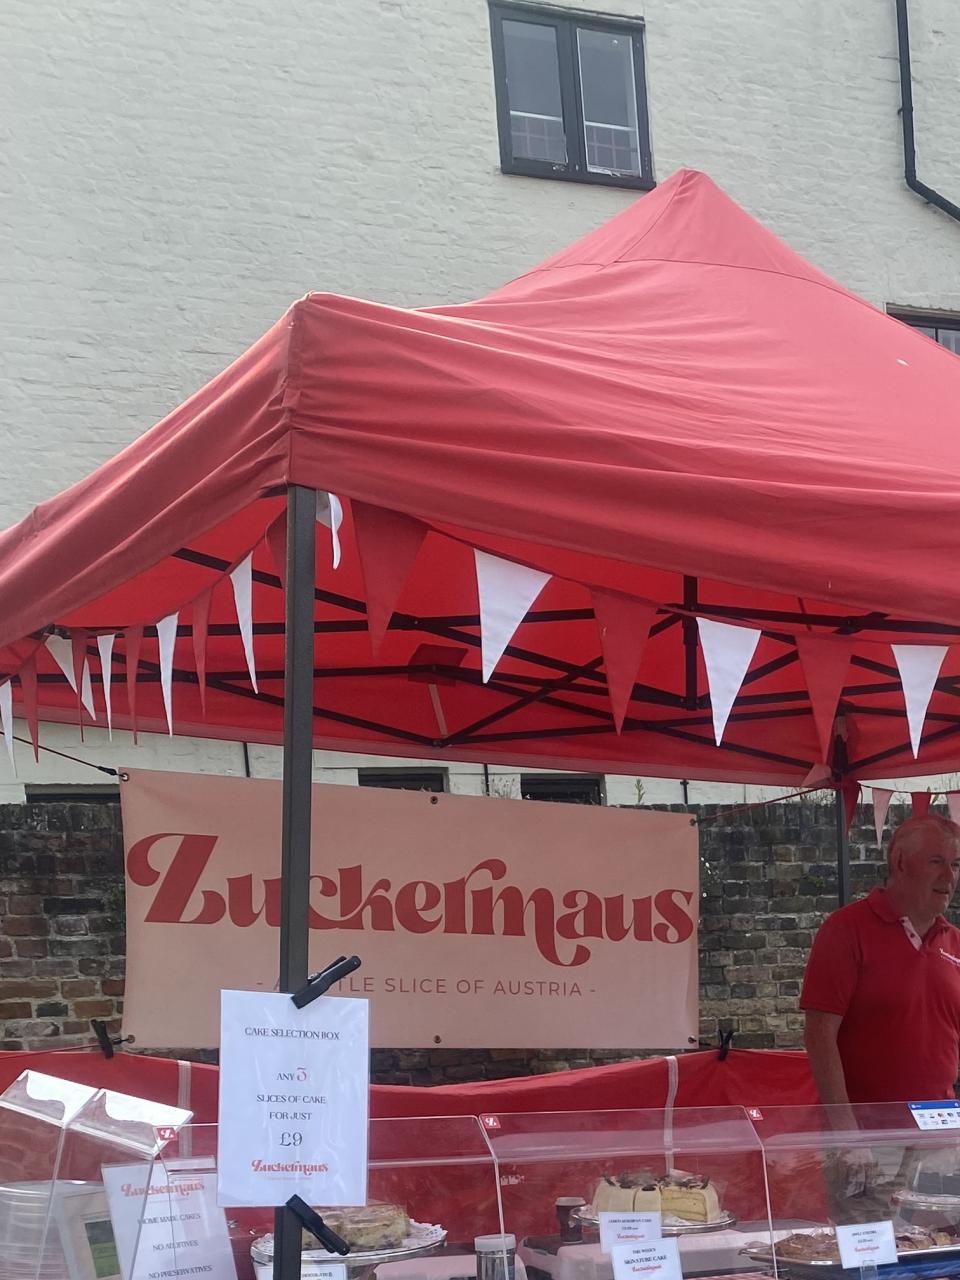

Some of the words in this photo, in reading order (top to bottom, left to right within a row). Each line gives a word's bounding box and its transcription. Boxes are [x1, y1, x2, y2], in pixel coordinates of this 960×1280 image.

[126, 833, 694, 967] Zuckermaus
[384, 978, 447, 993] SLICE
[456, 979, 485, 993] OF
[493, 980, 582, 996] AUSTRIA
[245, 1027, 269, 1037] CAKE
[271, 1029, 320, 1040] SELECTION
[321, 1031, 340, 1041] BOX
[277, 1073, 294, 1081] ANY
[257, 1095, 287, 1103] SLICES
[288, 1096, 301, 1104] OF
[302, 1096, 327, 1104] CAKE
[269, 1112, 289, 1120] FOR
[290, 1112, 312, 1121] JUST
[279, 1132, 303, 1147] £9
[160, 1265, 213, 1278] PRESERVATIVES
